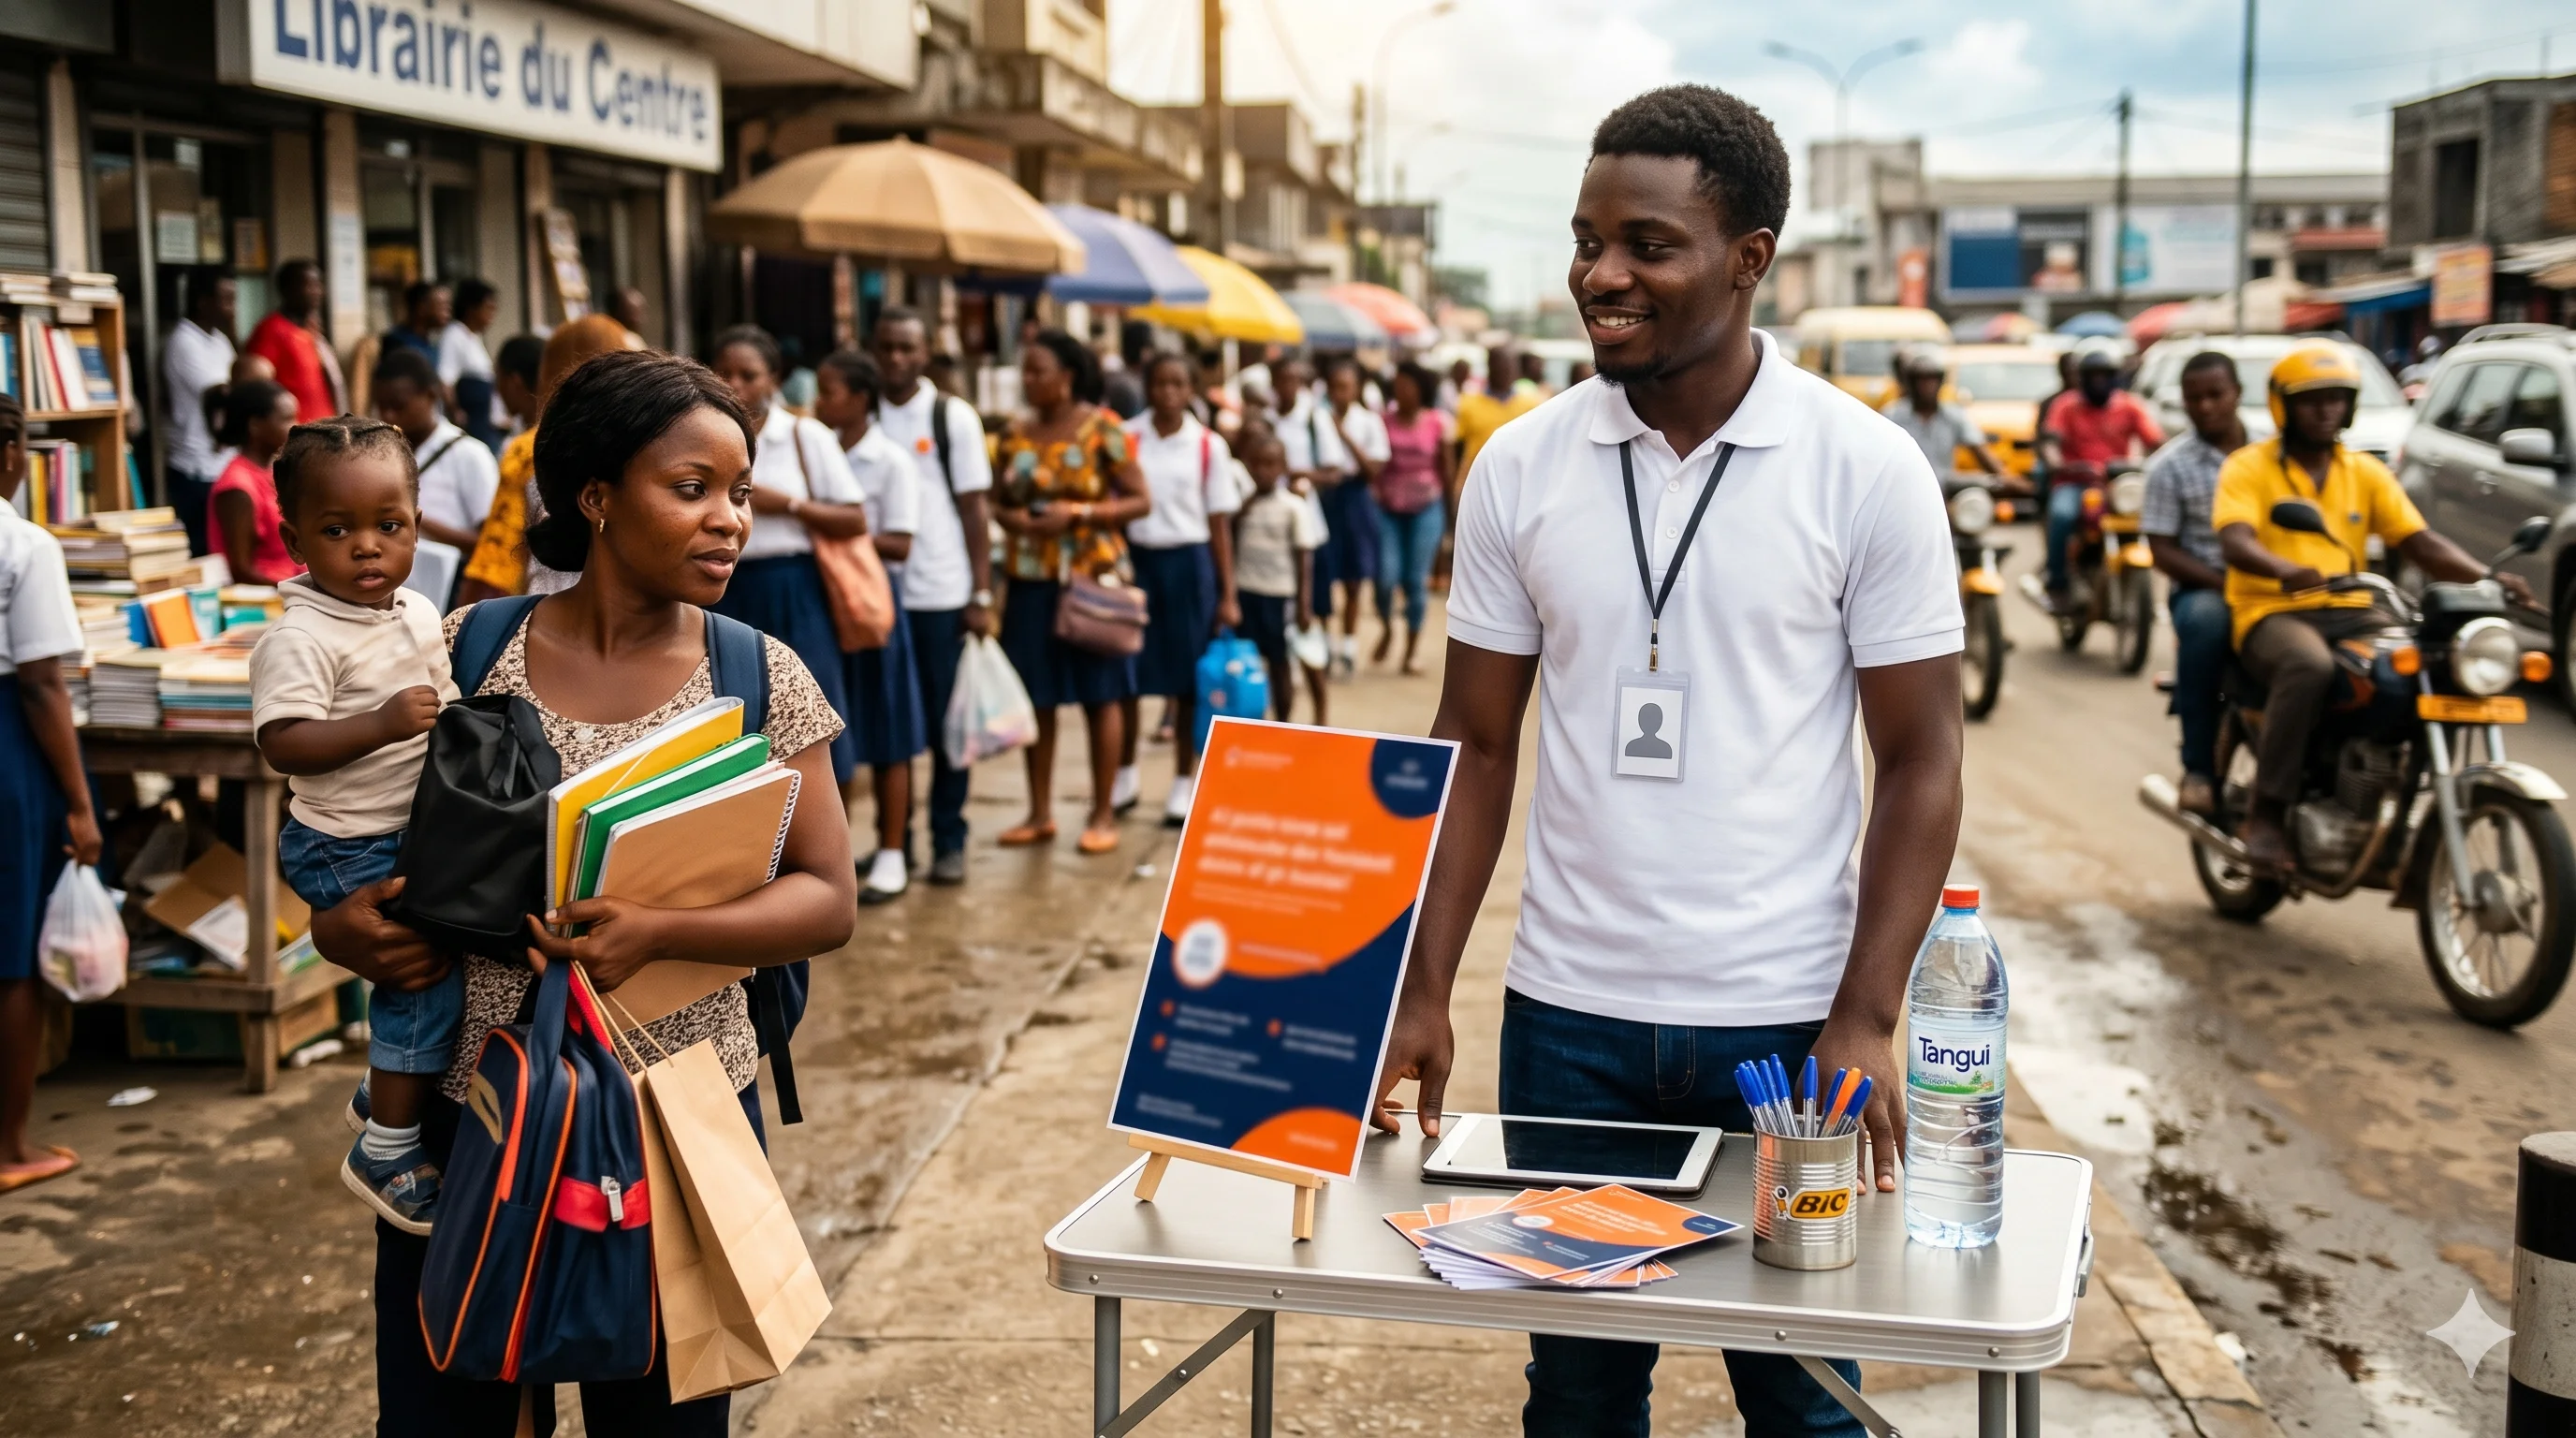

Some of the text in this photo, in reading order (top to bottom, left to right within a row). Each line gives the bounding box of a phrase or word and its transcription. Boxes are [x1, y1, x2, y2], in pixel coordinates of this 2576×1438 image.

[275, 0, 708, 140] Librairie du Centre
[1918, 1035, 1990, 1073] Tangui
[1794, 1193, 1848, 1214] BIC
